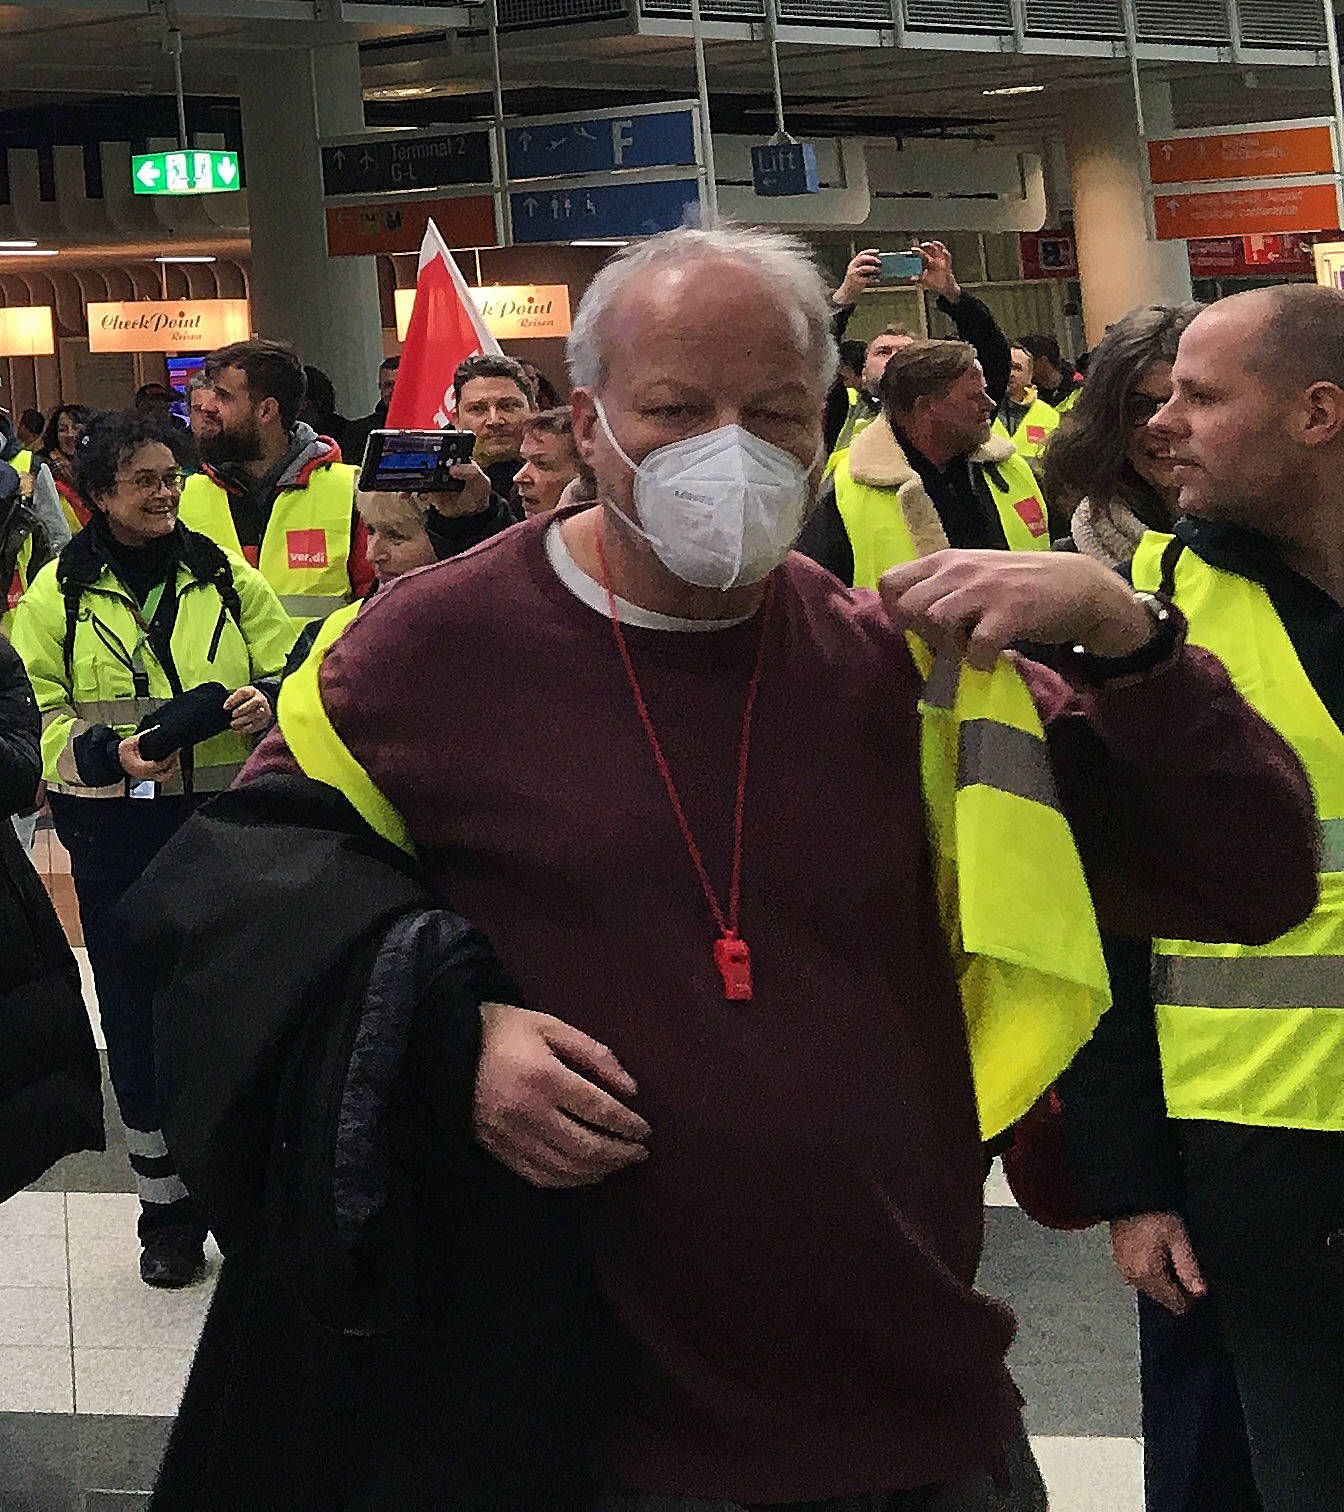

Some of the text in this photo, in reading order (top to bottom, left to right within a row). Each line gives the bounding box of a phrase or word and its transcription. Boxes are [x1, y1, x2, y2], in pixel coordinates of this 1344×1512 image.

[613, 120, 633, 165] F
[759, 147, 796, 172] Lift
[290, 552, 325, 563] ver.di
